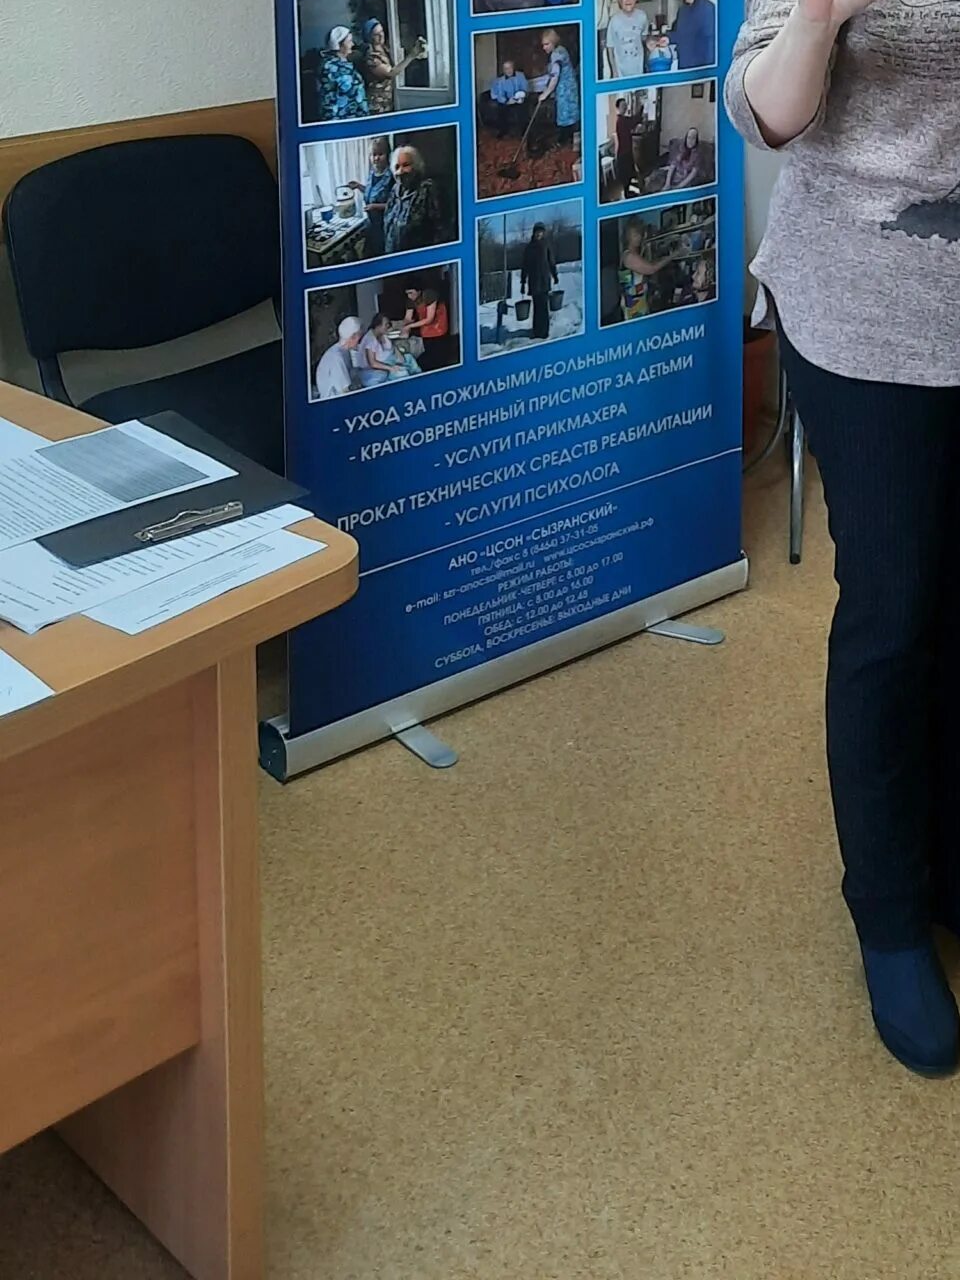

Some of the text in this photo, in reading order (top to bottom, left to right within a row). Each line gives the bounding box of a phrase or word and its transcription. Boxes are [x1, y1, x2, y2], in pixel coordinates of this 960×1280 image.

[344, 405, 400, 434] УХОД
[404, 401, 427, 417] ЗА
[431, 342, 633, 410] ПОЖИЛЫМИ/БОЛЬНЫМИ
[636, 324, 706, 355] ЛЮДЬМИ
[361, 400, 525, 462] КРАТКОВРЕМЕННЫЙ
[528, 377, 612, 413] ПРИСМОТР
[615, 372, 634, 388] ЗА
[637, 354, 693, 383] ДЕТЬМИ
[337, 404, 713, 532] ПРОКАТ ТЕХНИЧЕСКИХ СРЕДСТВ РЕАБИЛИТАЦИИ
[444, 435, 511, 469] УСЛУГИ
[515, 402, 628, 447] ПАРИКМАХЕРА
[455, 493, 521, 526] УСЛУГИ
[525, 462, 620, 503] ПСИХОЛОГА
[448, 551, 478, 570] АНО
